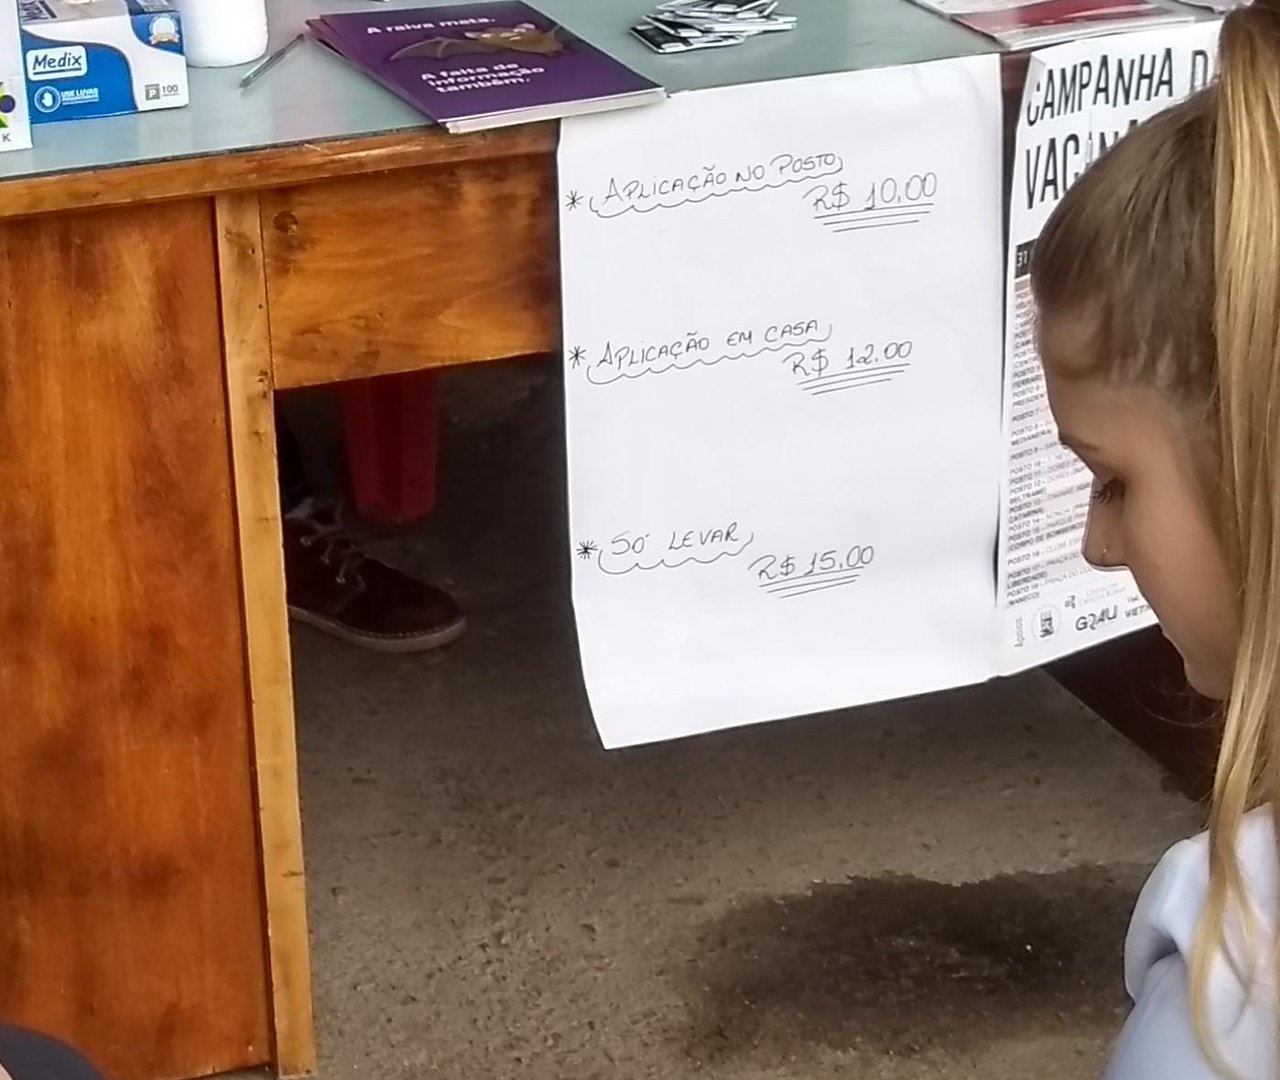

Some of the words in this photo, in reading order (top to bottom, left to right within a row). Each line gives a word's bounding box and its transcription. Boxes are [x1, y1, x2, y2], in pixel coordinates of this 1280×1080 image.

[367, 26, 381, 34] A
[386, 21, 435, 32] raiva
[439, 16, 496, 27] mata.
[33, 52, 82, 70] Medix
[421, 72, 436, 81] A
[439, 66, 487, 78] falta
[162, 85, 179, 93] 100
[427, 67, 545, 87] informação
[436, 77, 531, 93] também.
[1027, 48, 1173, 126] CAMPANHA
[602, 164, 726, 205] APLICAÇÃO
[736, 165, 765, 183] NO
[770, 152, 837, 177] POSTO
[802, 181, 850, 212] R$
[597, 331, 710, 369] APLICAÇÃO
[727, 329, 753, 347] EM
[764, 319, 818, 343] CASA
[783, 347, 829, 376] R$
[669, 522, 740, 551] LEVAR
[748, 554, 796, 580] R$
